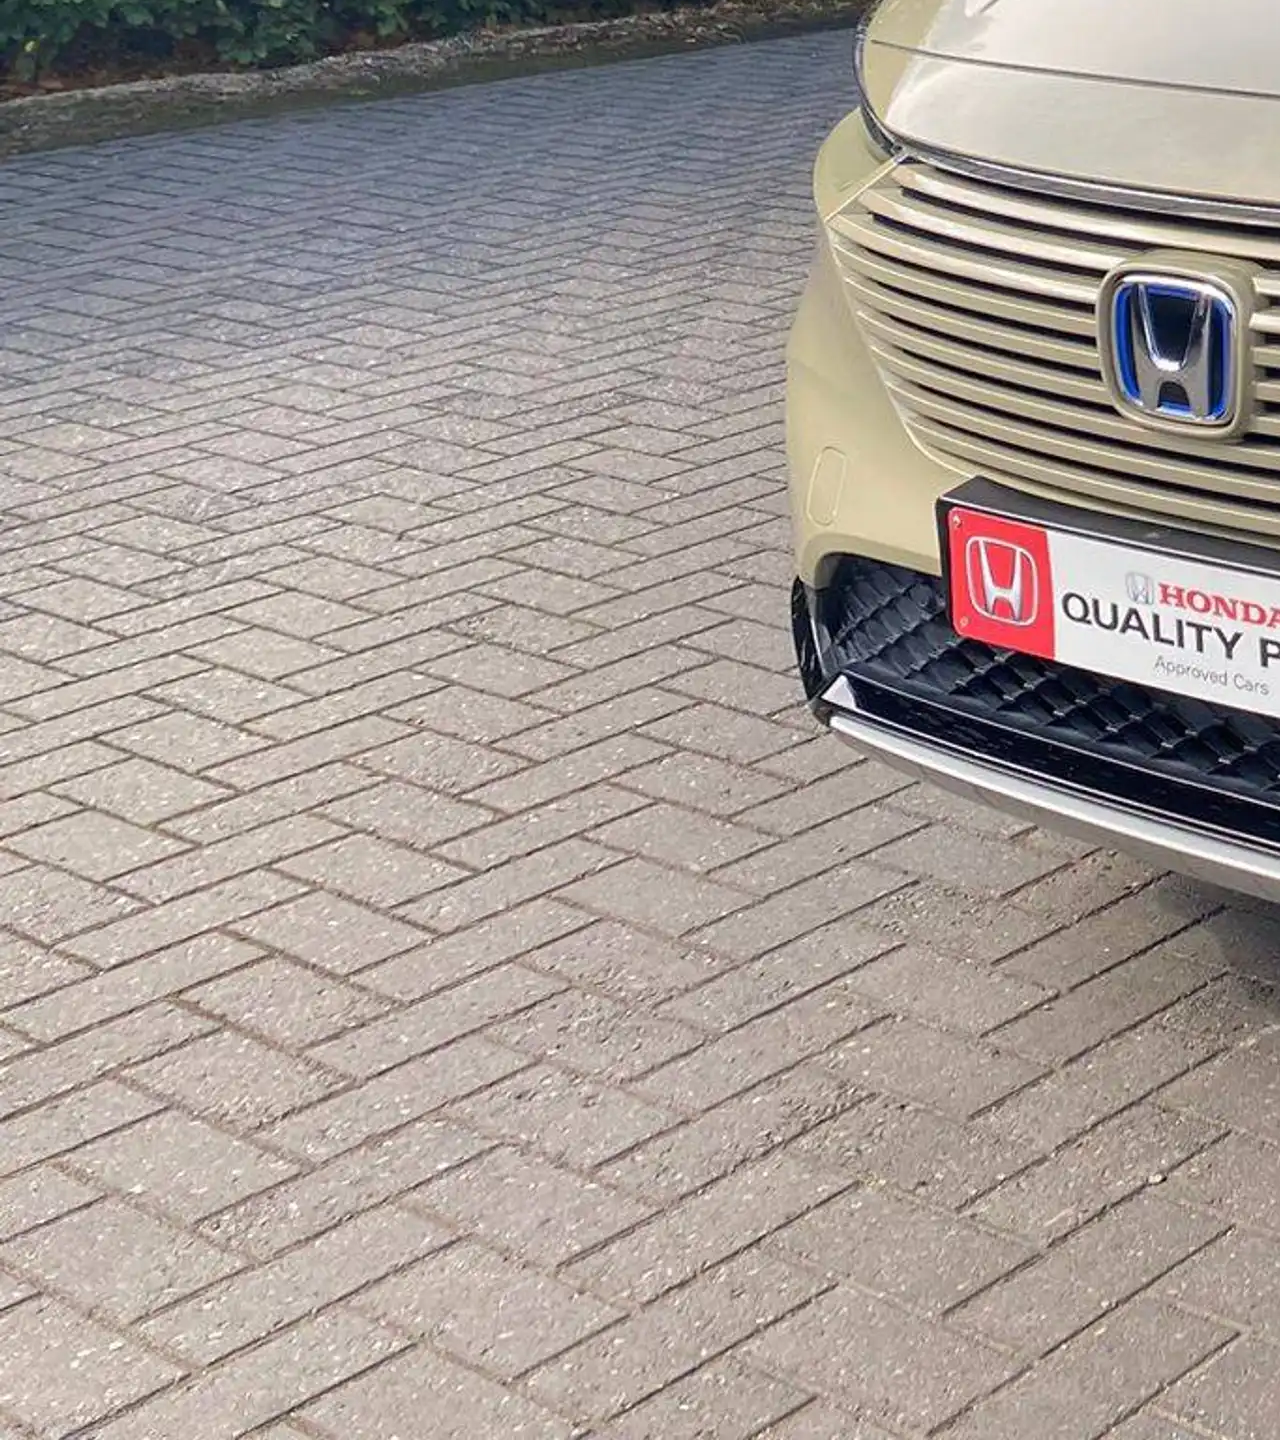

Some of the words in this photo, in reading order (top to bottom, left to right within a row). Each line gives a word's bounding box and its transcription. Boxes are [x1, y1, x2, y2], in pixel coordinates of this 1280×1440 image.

[1061, 592, 1244, 660] QUALITY
[1154, 655, 1228, 687] Approved
[1233, 674, 1270, 696] Cars
